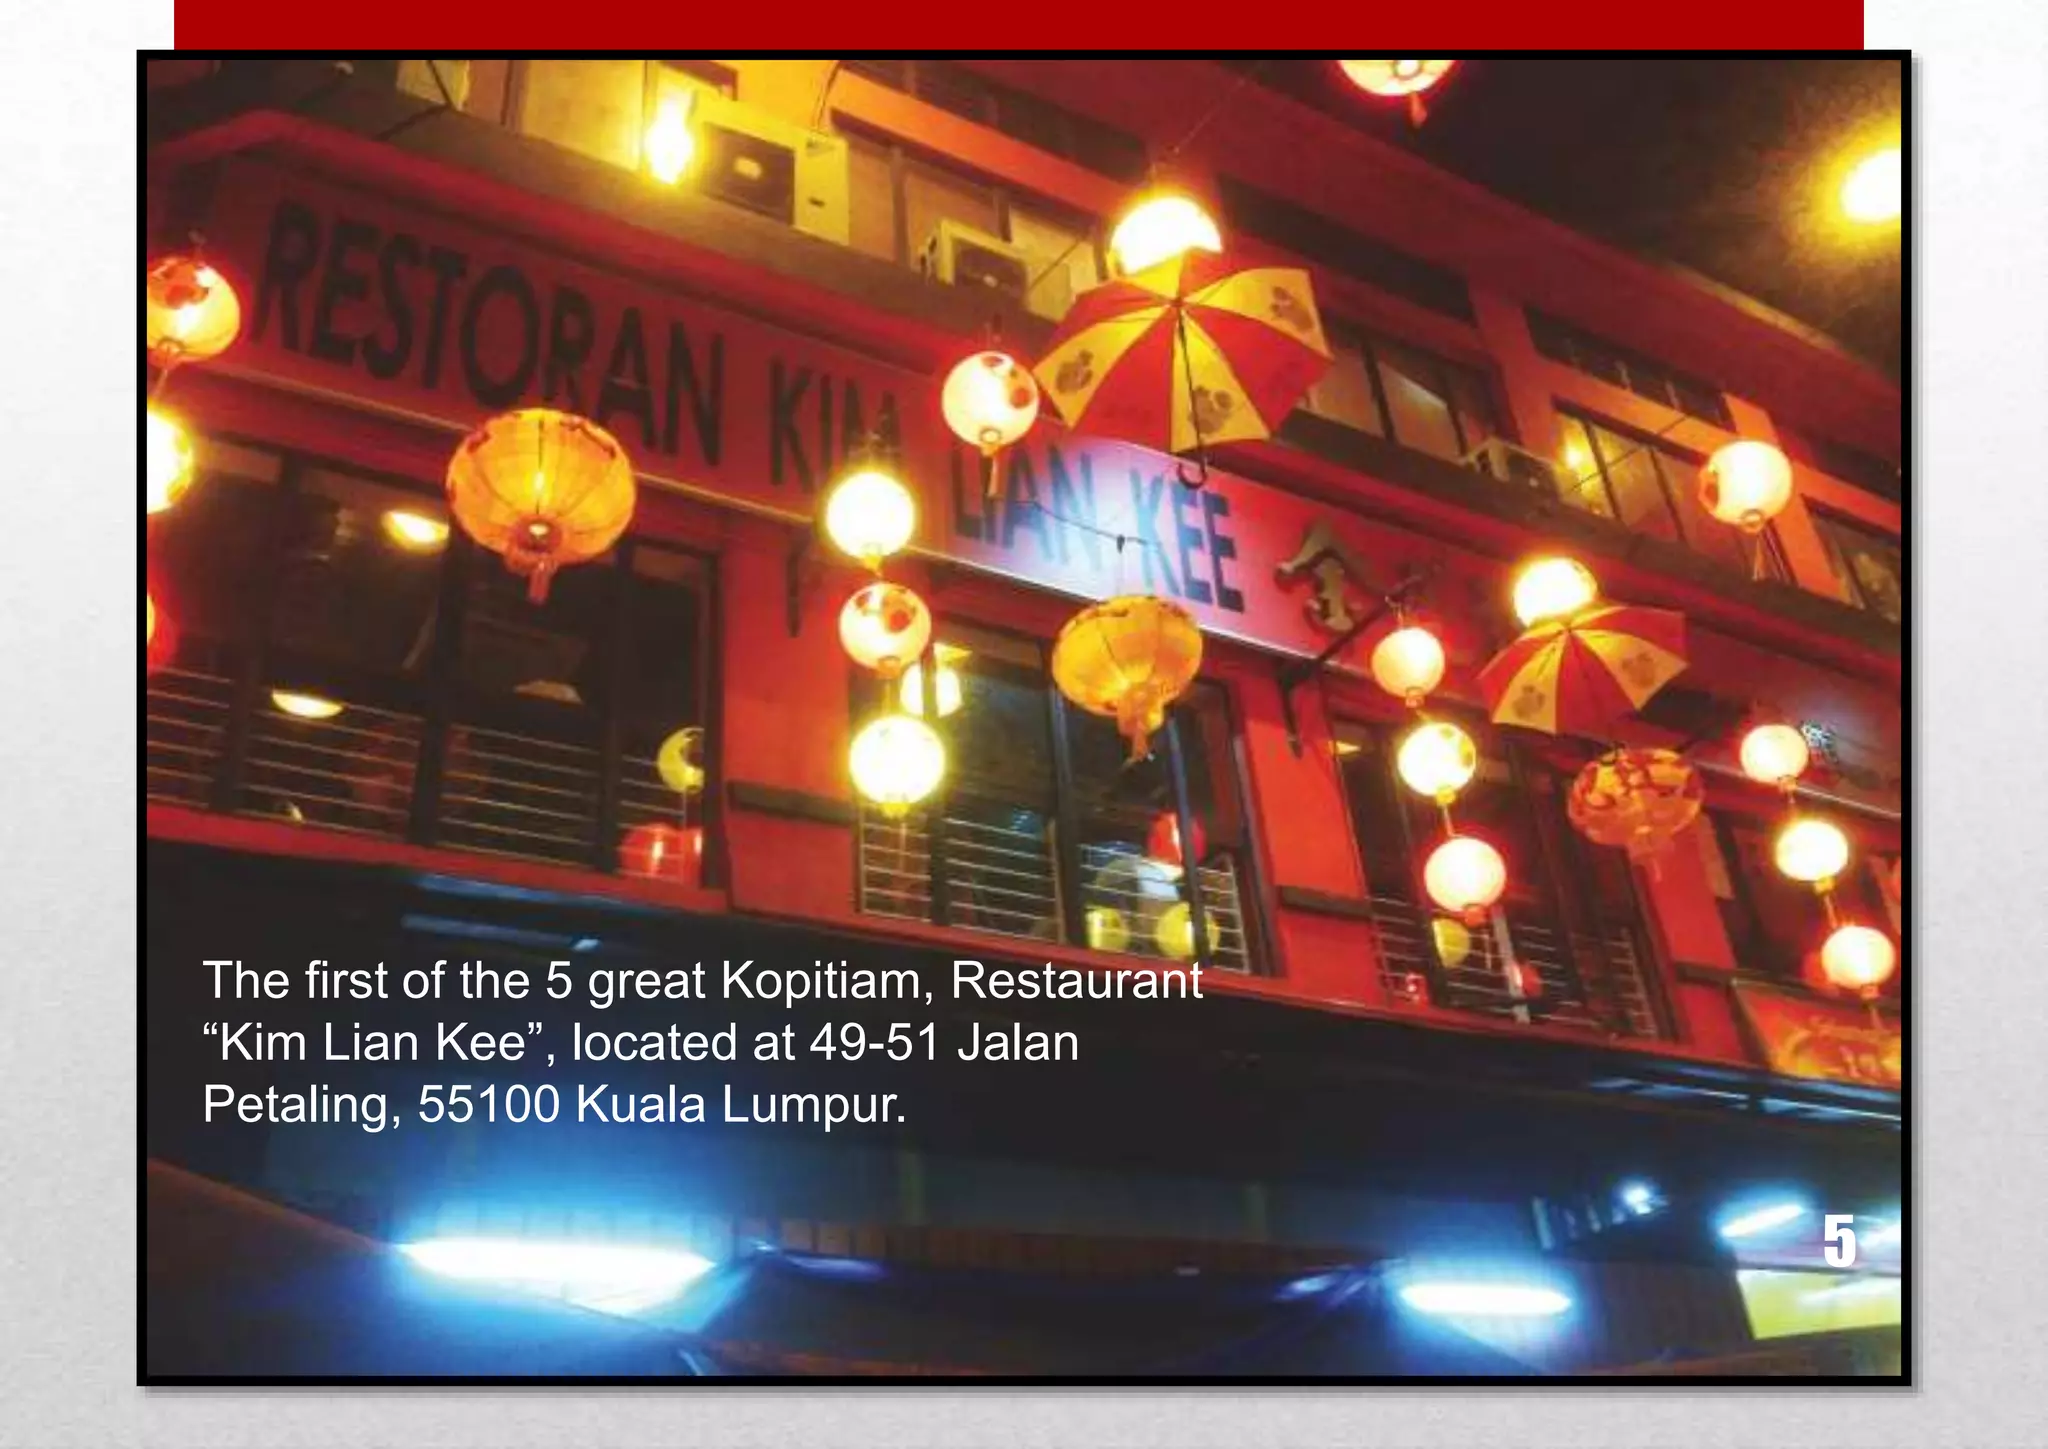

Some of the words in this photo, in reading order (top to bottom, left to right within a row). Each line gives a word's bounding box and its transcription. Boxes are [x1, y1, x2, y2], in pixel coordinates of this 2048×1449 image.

[250, 198, 724, 466] RESTORAN
[768, 357, 902, 494] KIM
[951, 443, 1102, 570] LIAN
[1128, 466, 1246, 614] KEE
